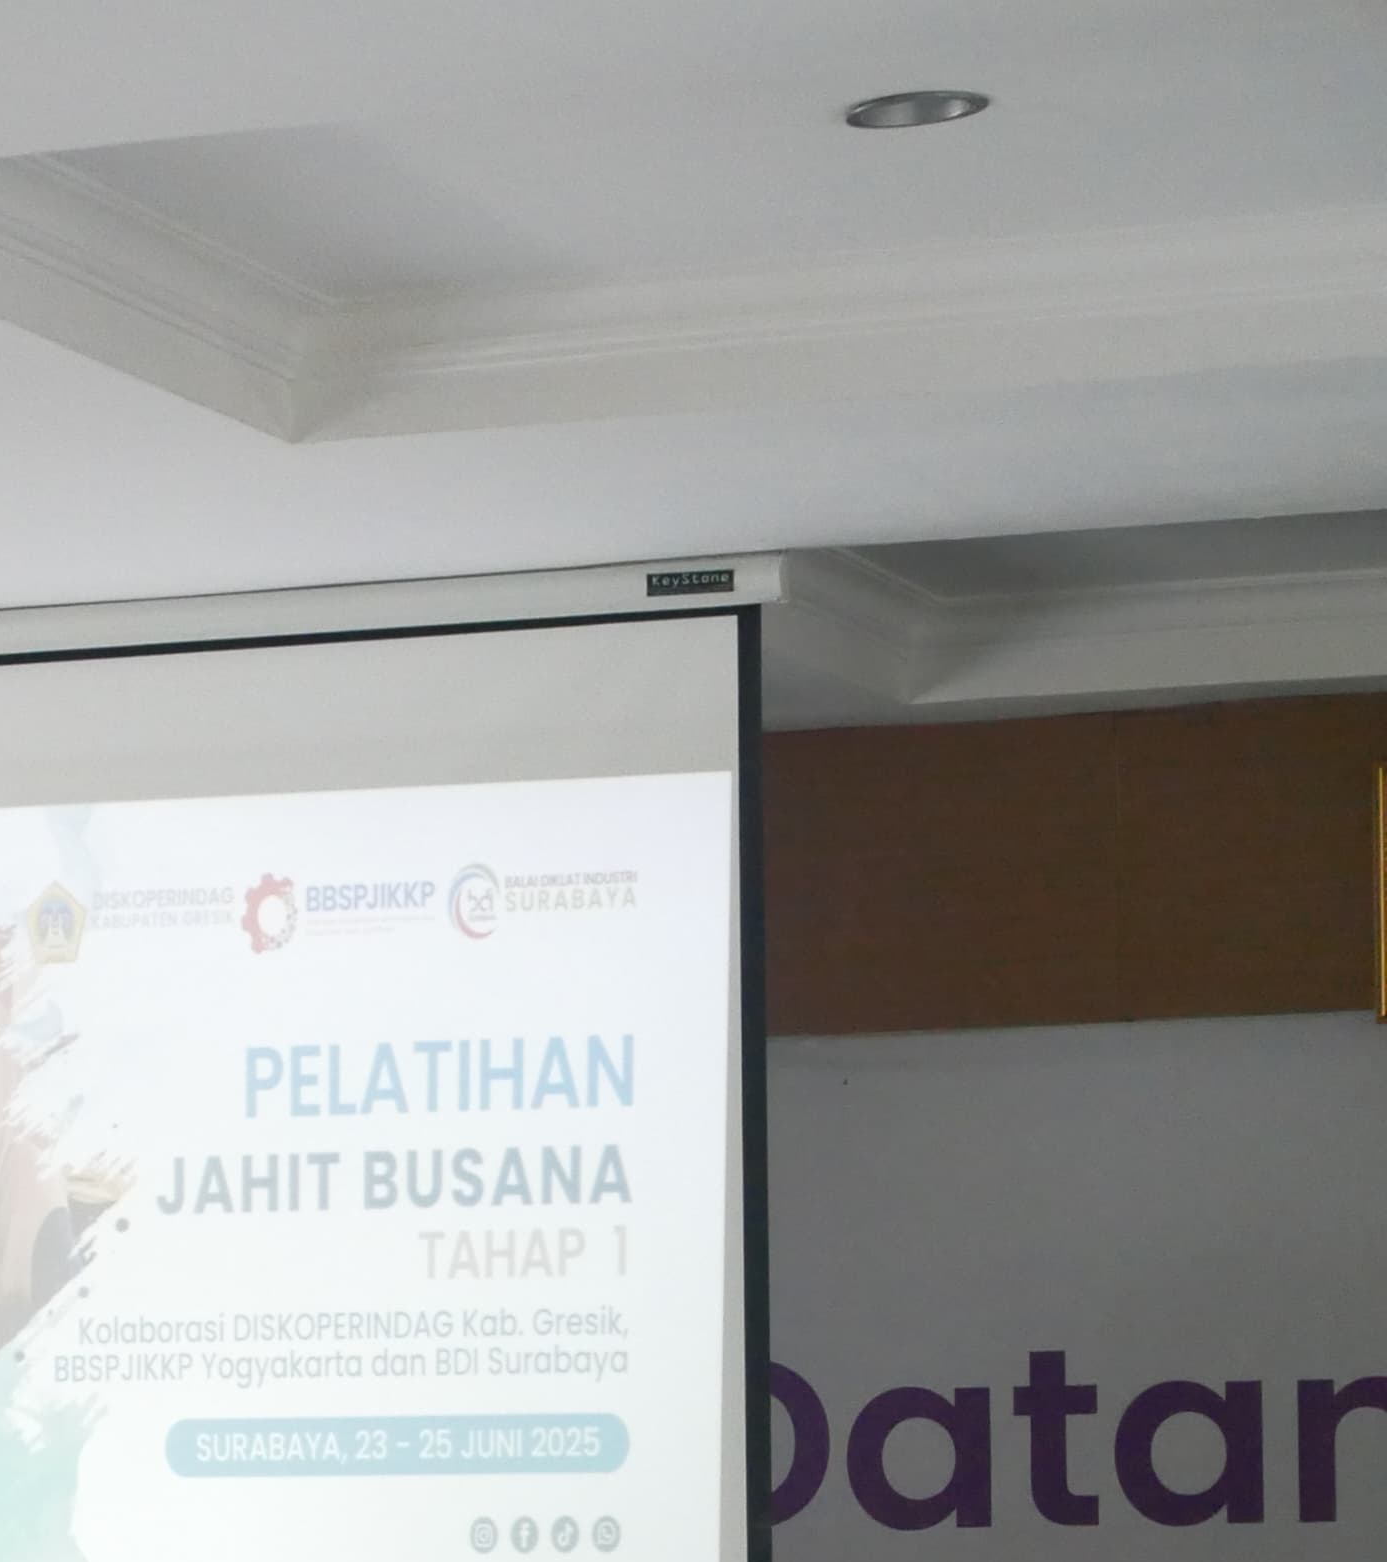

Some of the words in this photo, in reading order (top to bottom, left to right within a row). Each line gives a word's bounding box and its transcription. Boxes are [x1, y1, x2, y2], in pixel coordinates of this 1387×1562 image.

[306, 880, 435, 912] BBSPJIKKP
[505, 886, 636, 912] SURABAYA
[246, 1034, 634, 1118] PELATIHAN
[157, 1152, 341, 1215] JAHIT
[364, 1144, 632, 1209] BUSANA
[419, 1227, 586, 1279] TAHAP
[613, 1224, 627, 1276] 1
[79, 1313, 224, 1344] Kolaborasi
[234, 1310, 454, 1341] DISKOPERINDAG
[463, 1308, 523, 1336] Kab.
[533, 1305, 628, 1338] Gresik,
[54, 1353, 193, 1382] BBSPJIKKP
[202, 1350, 363, 1389] Yogyakarta
[371, 1348, 426, 1376] dan
[436, 1347, 478, 1376] BDI
[488, 1344, 628, 1382] Surabaya
[196, 1432, 347, 1464] SURABAYA,
[355, 1430, 387, 1459] 23
[419, 1429, 452, 1459] 25
[461, 1429, 522, 1459] JUNI
[531, 1427, 600, 1456] 2025
